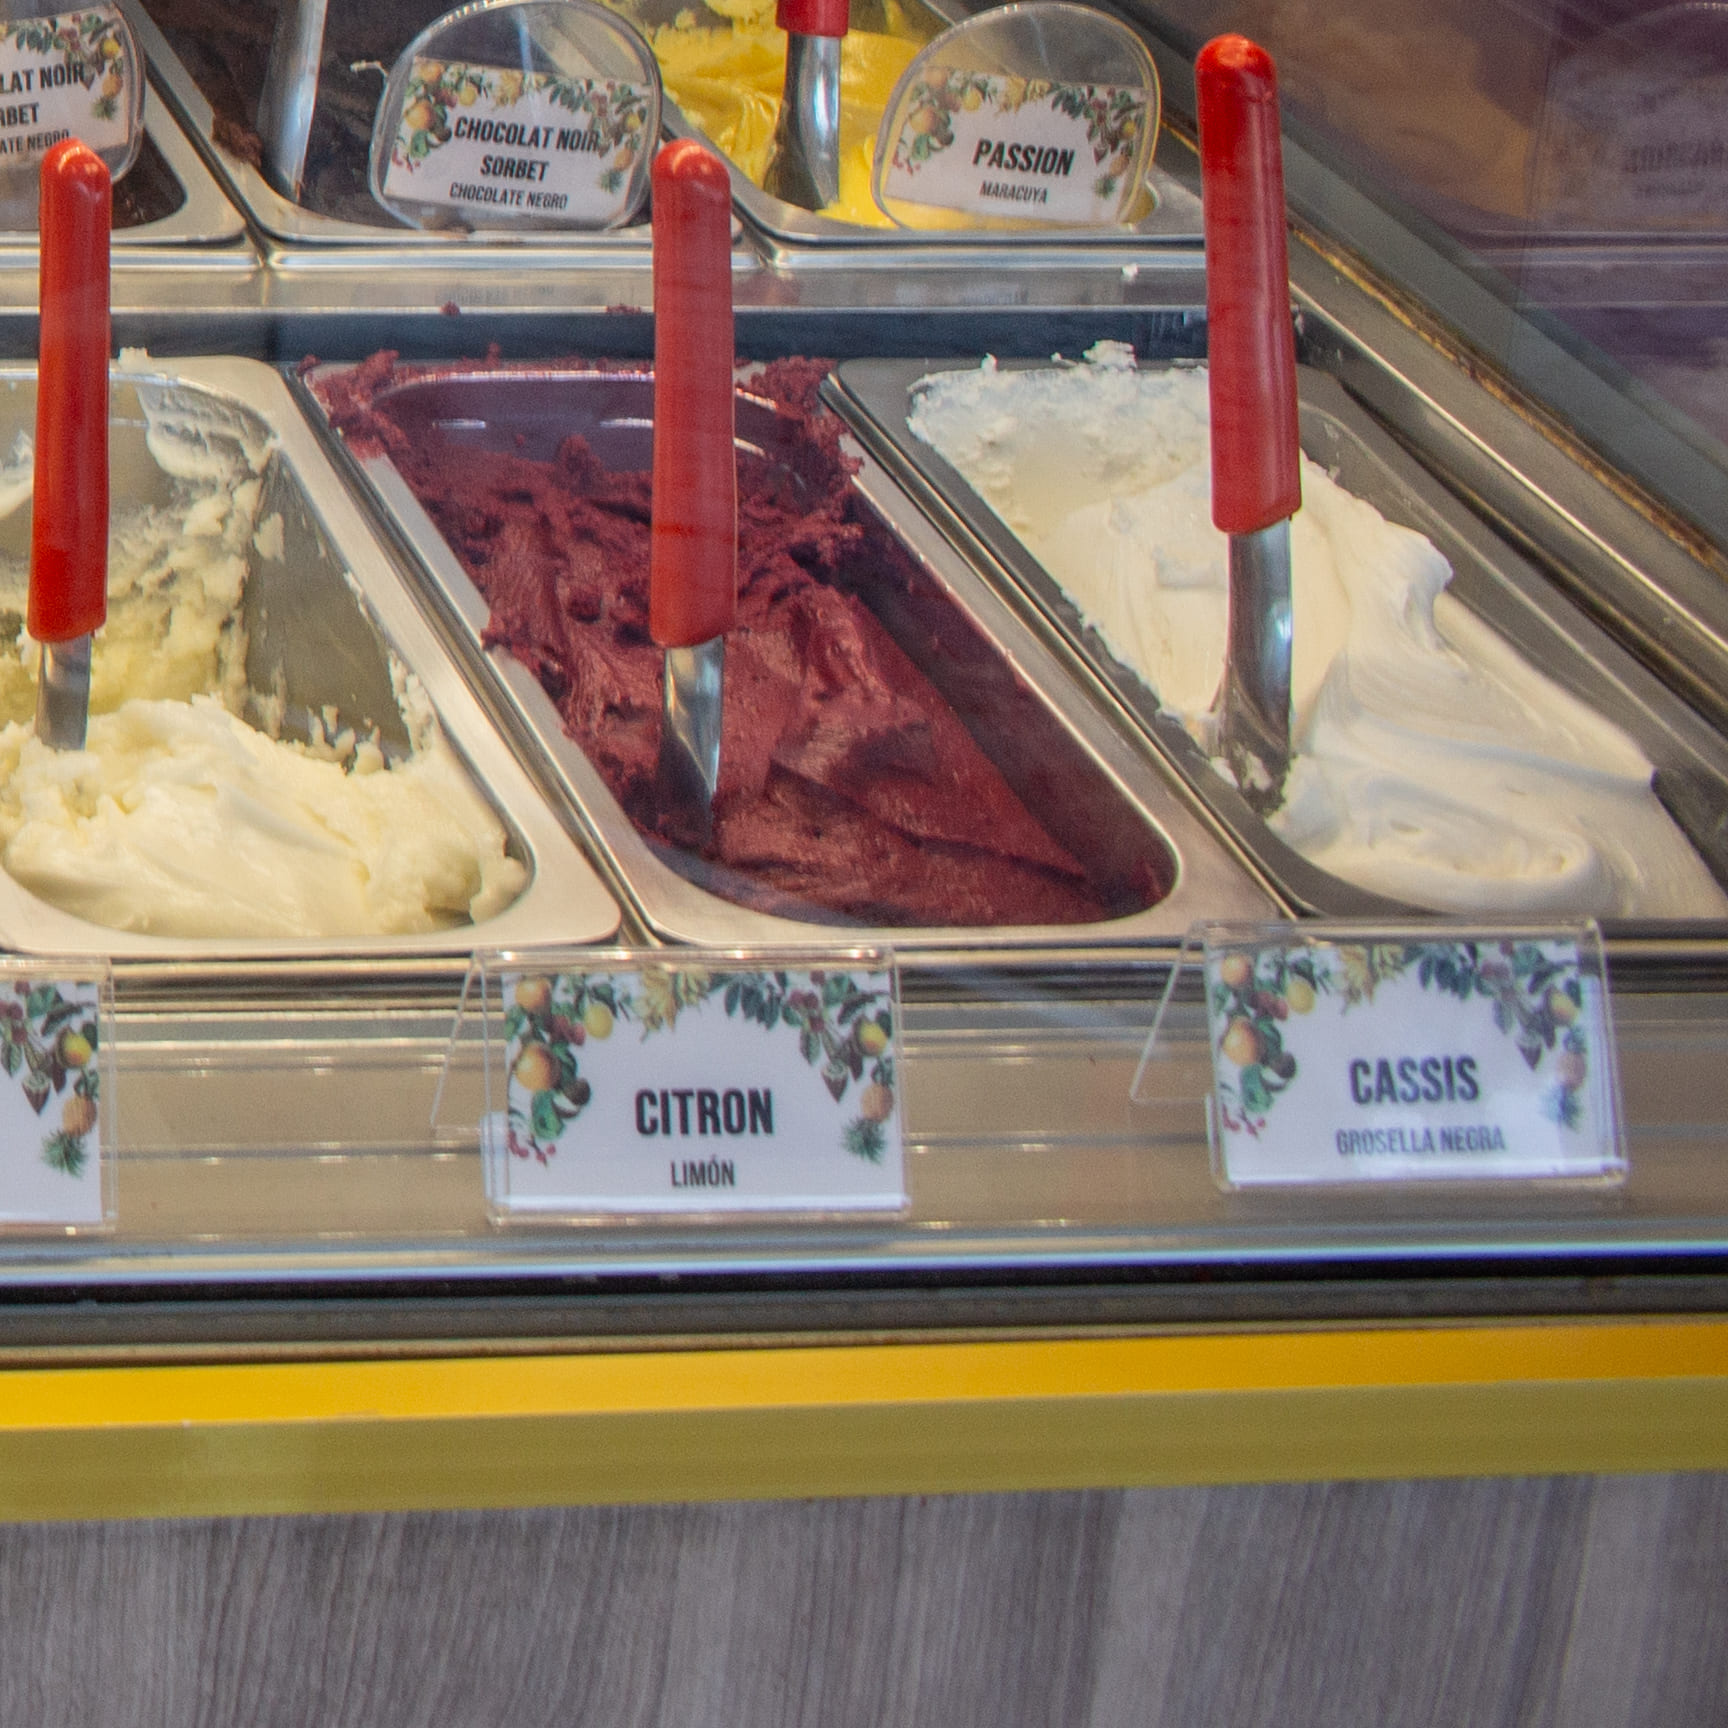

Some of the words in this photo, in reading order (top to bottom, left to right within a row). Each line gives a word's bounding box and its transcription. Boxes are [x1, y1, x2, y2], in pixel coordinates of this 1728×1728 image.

[39, 62, 86, 90] NOIR
[454, 116, 555, 149] CHOCOLAT
[556, 128, 602, 152] NOIR
[480, 154, 550, 182] SORBET
[972, 138, 1076, 176] PASSION
[449, 182, 526, 207] CHOCOLATE
[526, 190, 569, 210] NEGRO
[979, 180, 1049, 204] MARACUYA
[1350, 1056, 1481, 1105] CASSIS
[635, 1088, 774, 1136] CITRON
[1336, 1128, 1436, 1155] GROSELLA
[1439, 1126, 1507, 1154] NEGRA
[671, 1154, 736, 1187] LIMÓN
